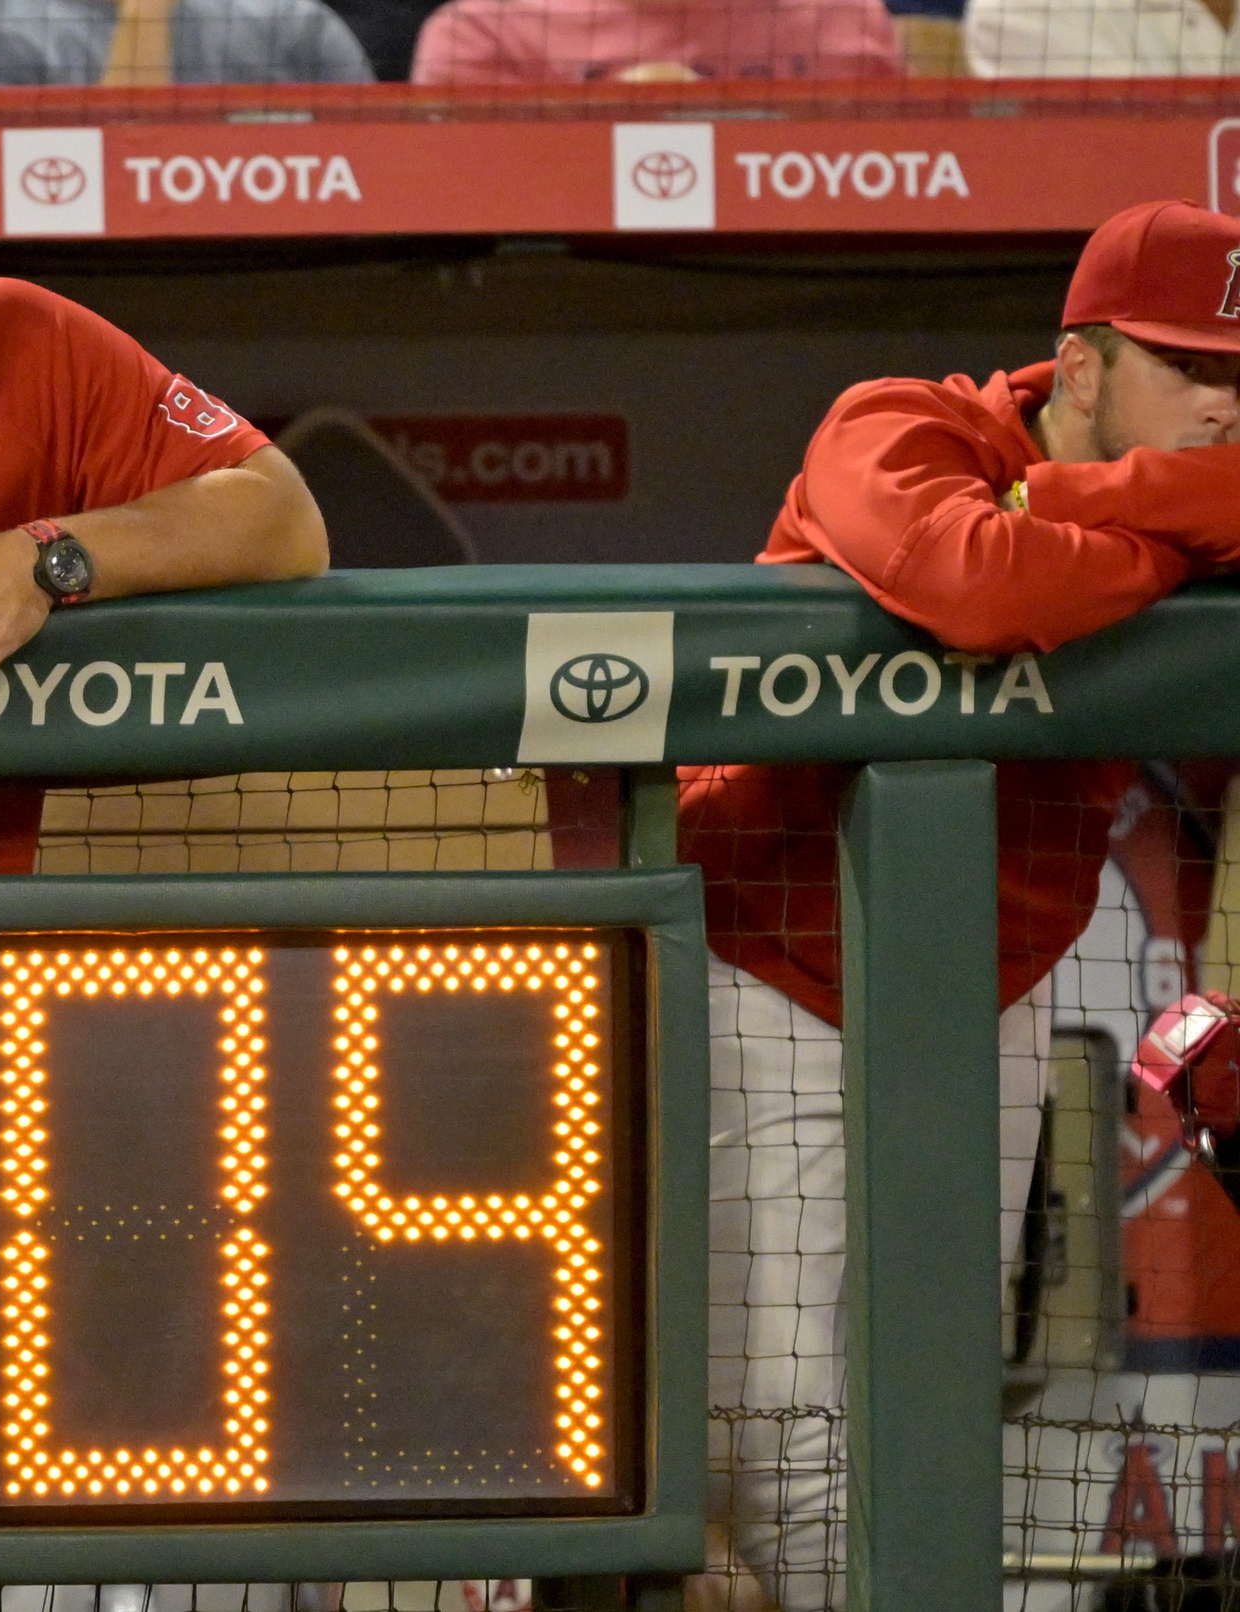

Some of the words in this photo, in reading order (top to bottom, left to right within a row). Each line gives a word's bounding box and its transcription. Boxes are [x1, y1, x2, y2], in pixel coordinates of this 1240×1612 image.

[124, 155, 363, 203] TOYOTA
[735, 151, 970, 199] TOYOTA
[710, 650, 1054, 717] TOYOTA
